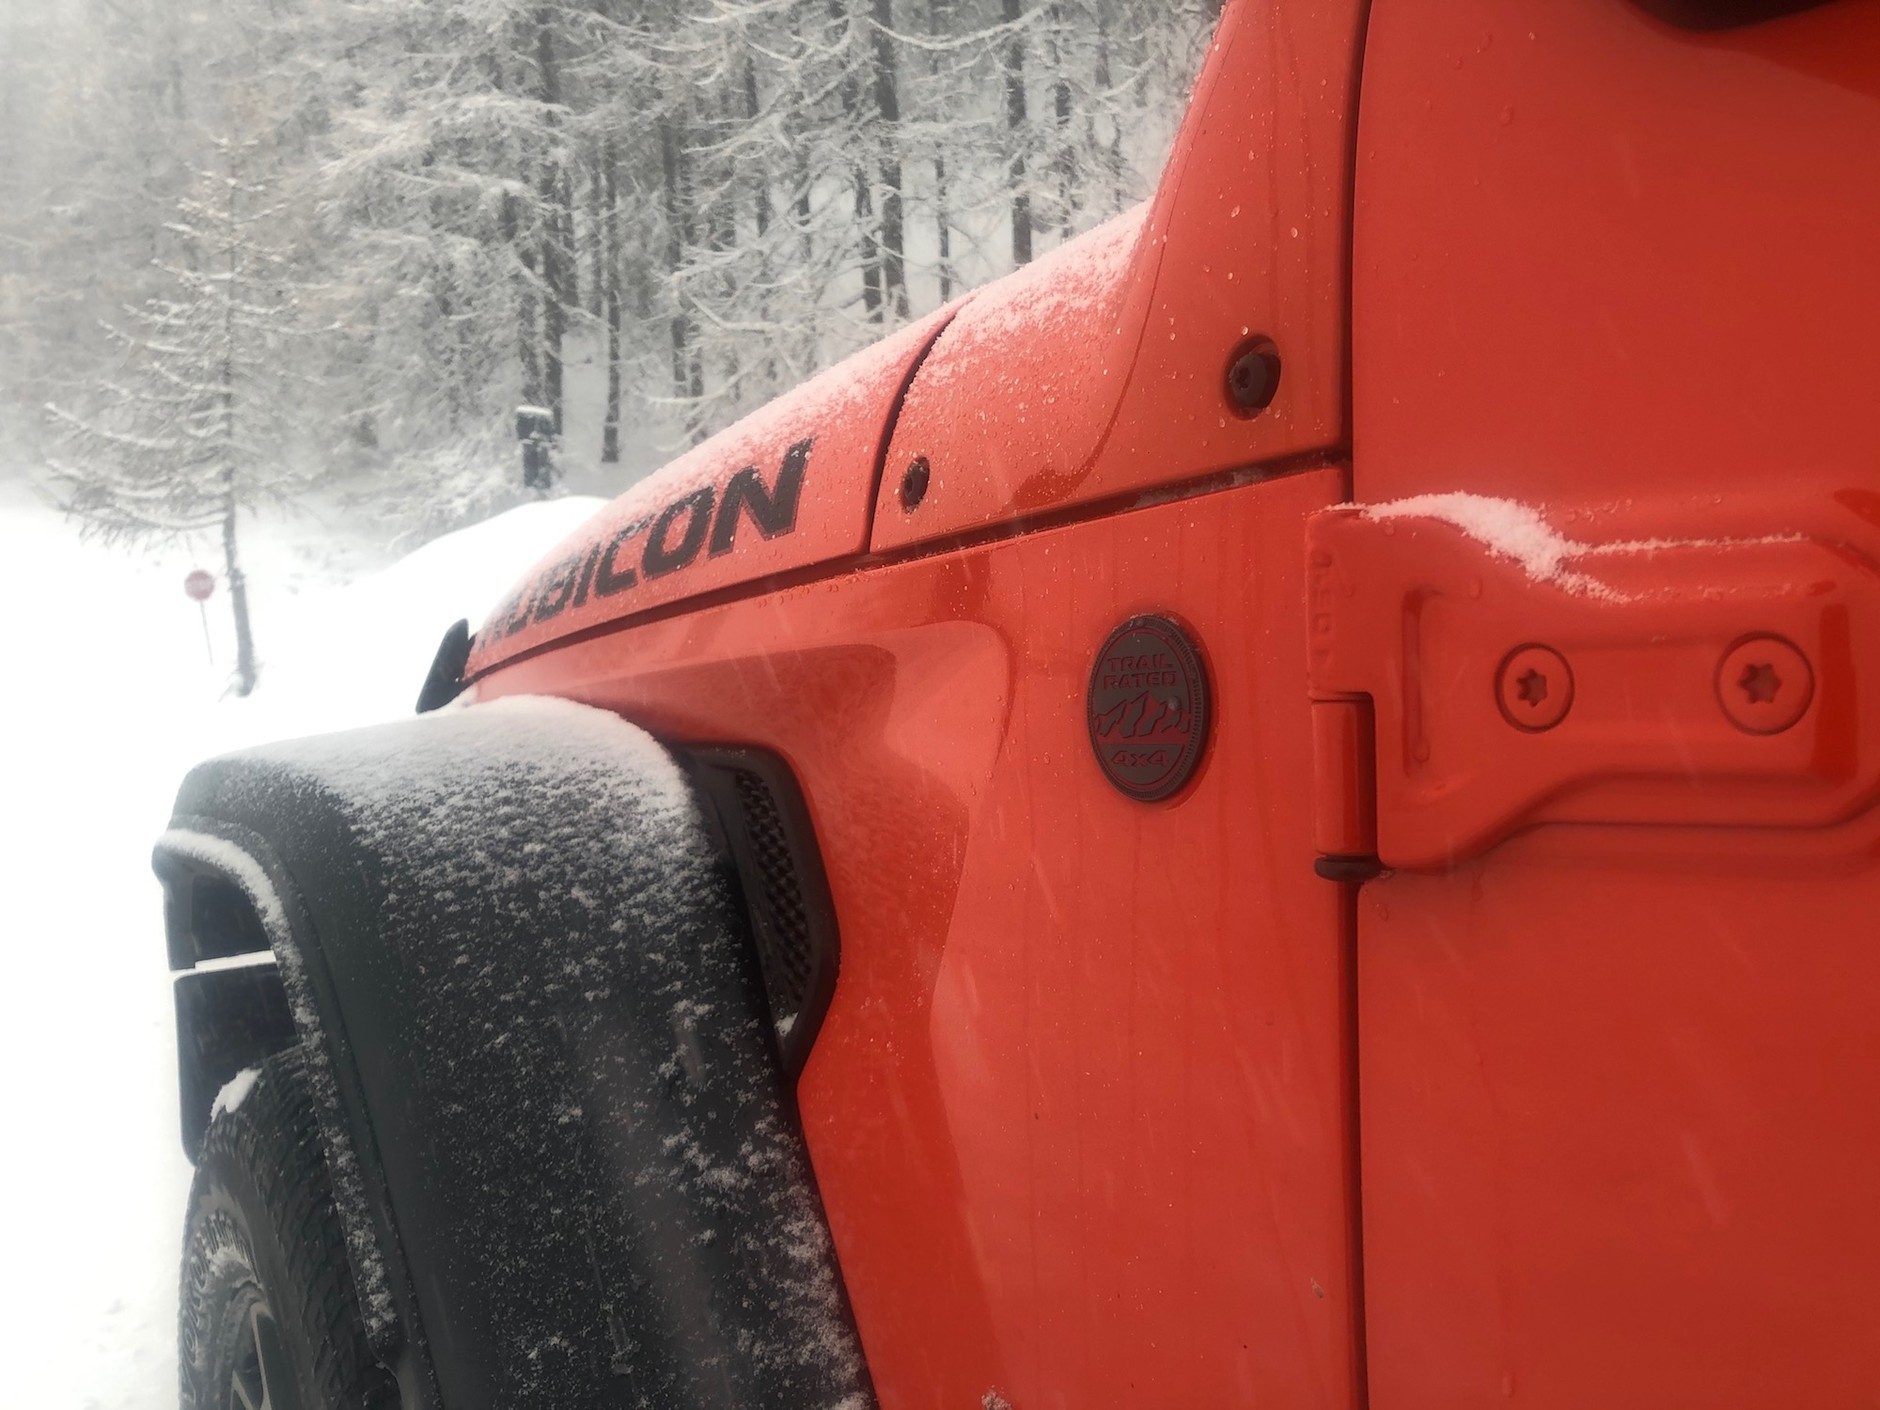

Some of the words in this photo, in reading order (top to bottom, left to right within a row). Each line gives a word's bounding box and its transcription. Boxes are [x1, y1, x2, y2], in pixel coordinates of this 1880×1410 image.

[477, 437, 816, 652] UBICON
[1107, 653, 1174, 673] TRAIL
[1103, 671, 1178, 690] RATED
